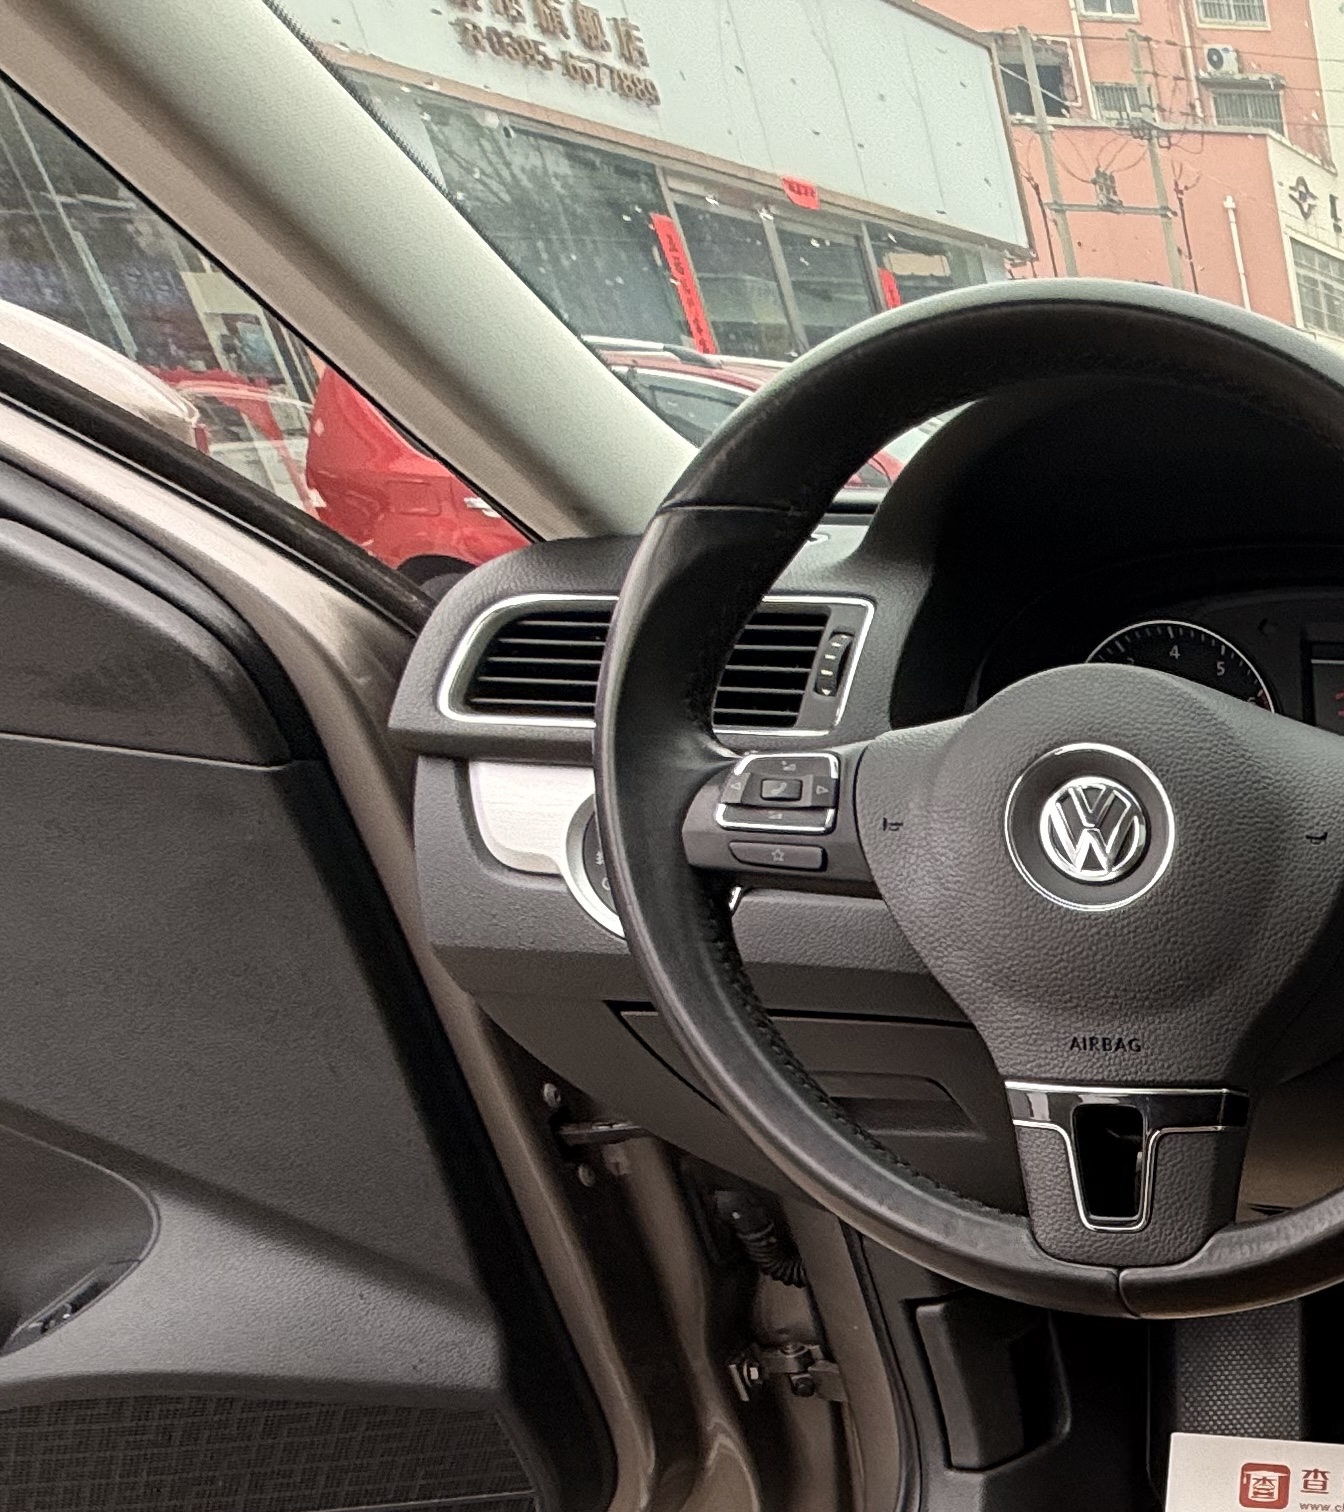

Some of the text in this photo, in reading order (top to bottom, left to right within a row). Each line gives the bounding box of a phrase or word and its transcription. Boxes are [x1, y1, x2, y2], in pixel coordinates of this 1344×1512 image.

[1169, 645, 1181, 660] 4
[1215, 661, 1226, 676] 5
[1069, 1035, 1142, 1053] AIRBAG
